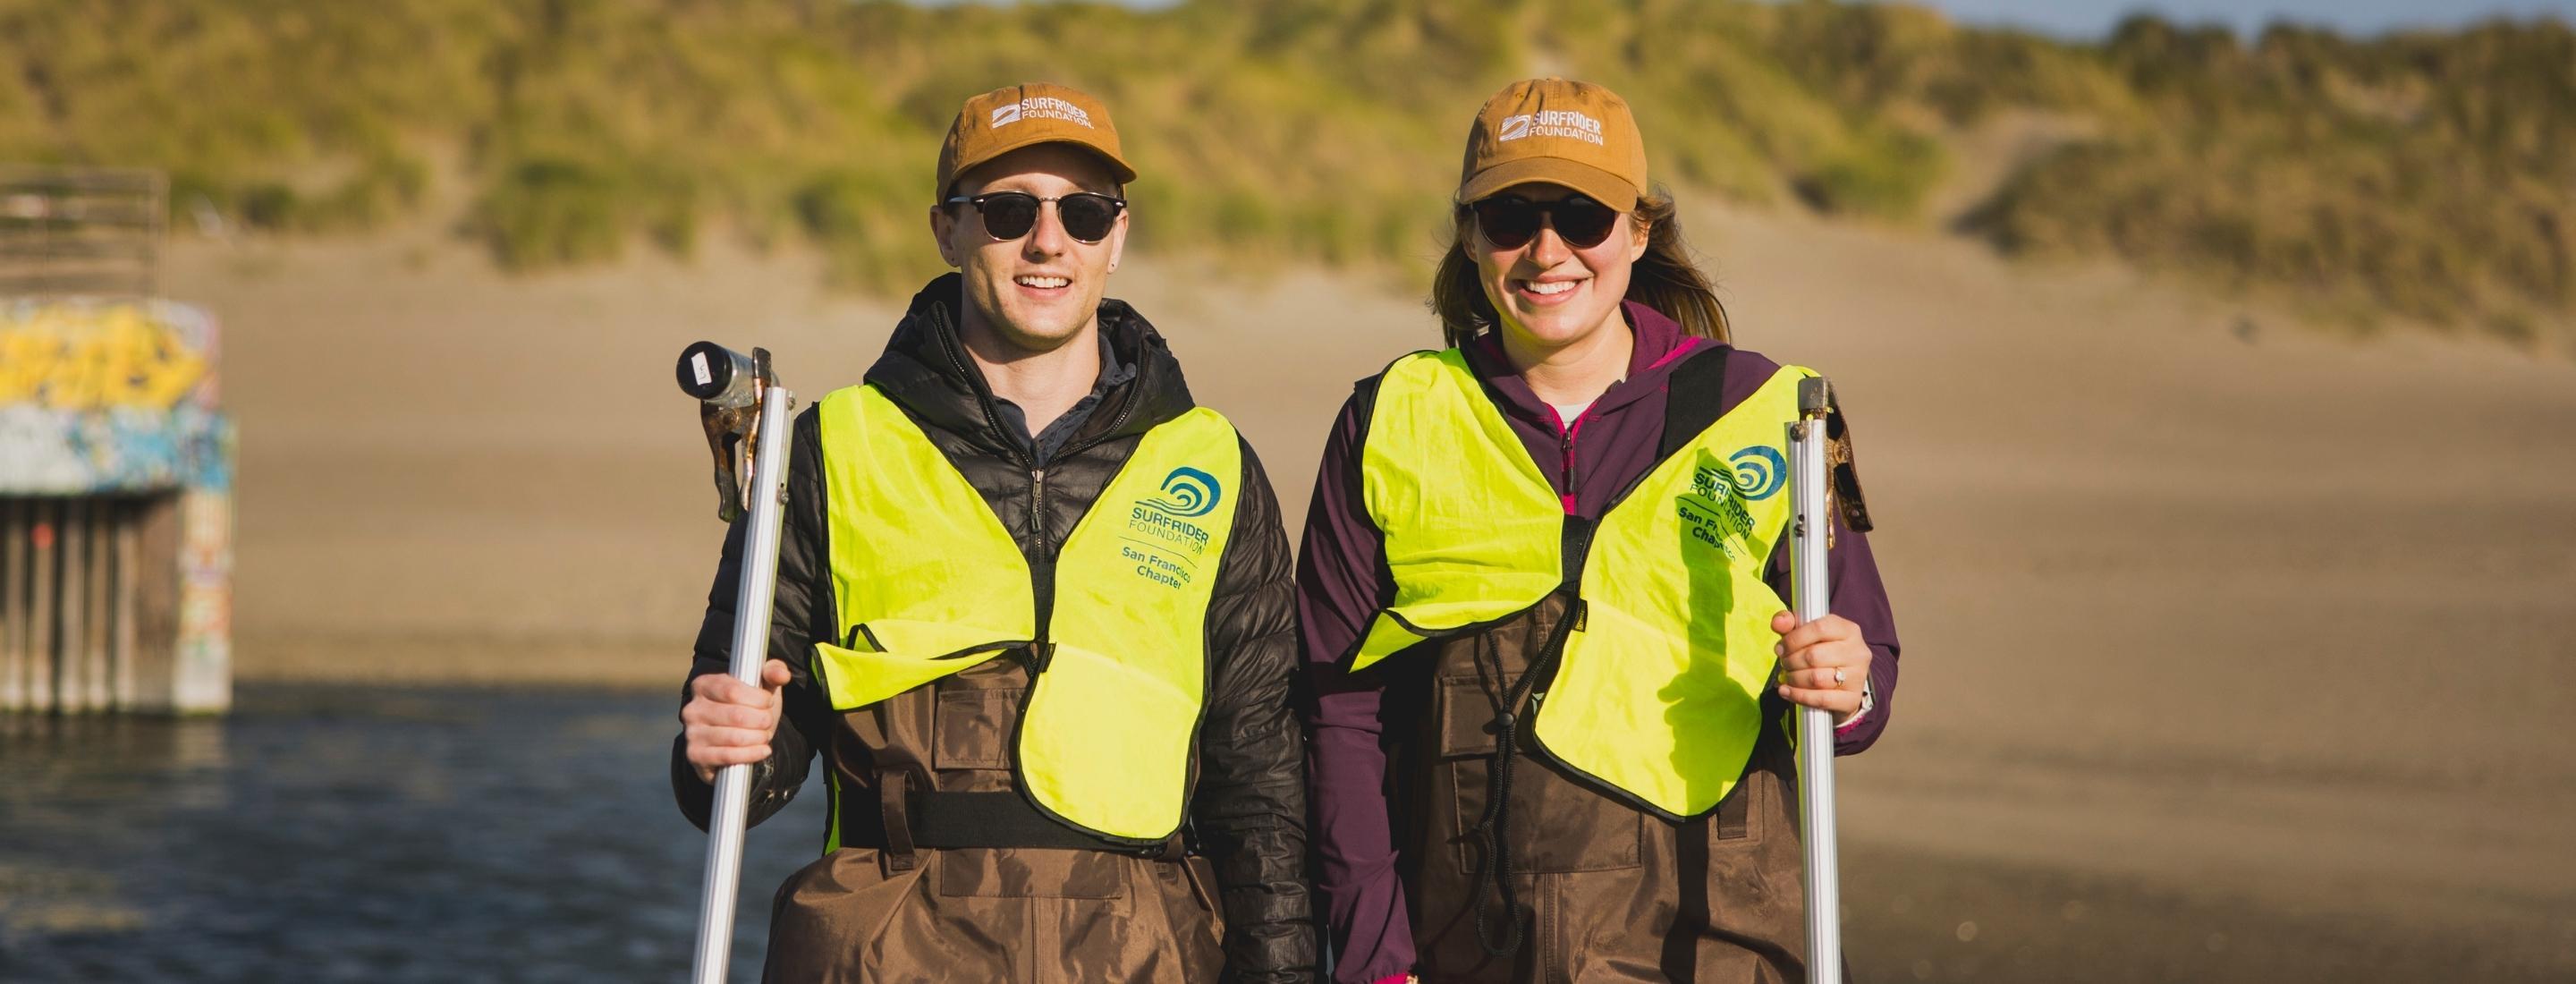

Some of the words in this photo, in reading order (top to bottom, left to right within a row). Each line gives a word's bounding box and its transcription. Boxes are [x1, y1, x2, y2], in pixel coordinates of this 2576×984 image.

[1021, 98, 1089, 119] SURFRIDER
[1532, 110, 1601, 134] SURFRIDER
[1529, 126, 1604, 146] FOUNDATION
[1678, 506, 1703, 524] San
[1129, 519, 1205, 556] FOUNDATION
[1131, 507, 1209, 546] SURFRIDER
[1122, 547, 1146, 563] San
[1137, 565, 1182, 590] Chapter
